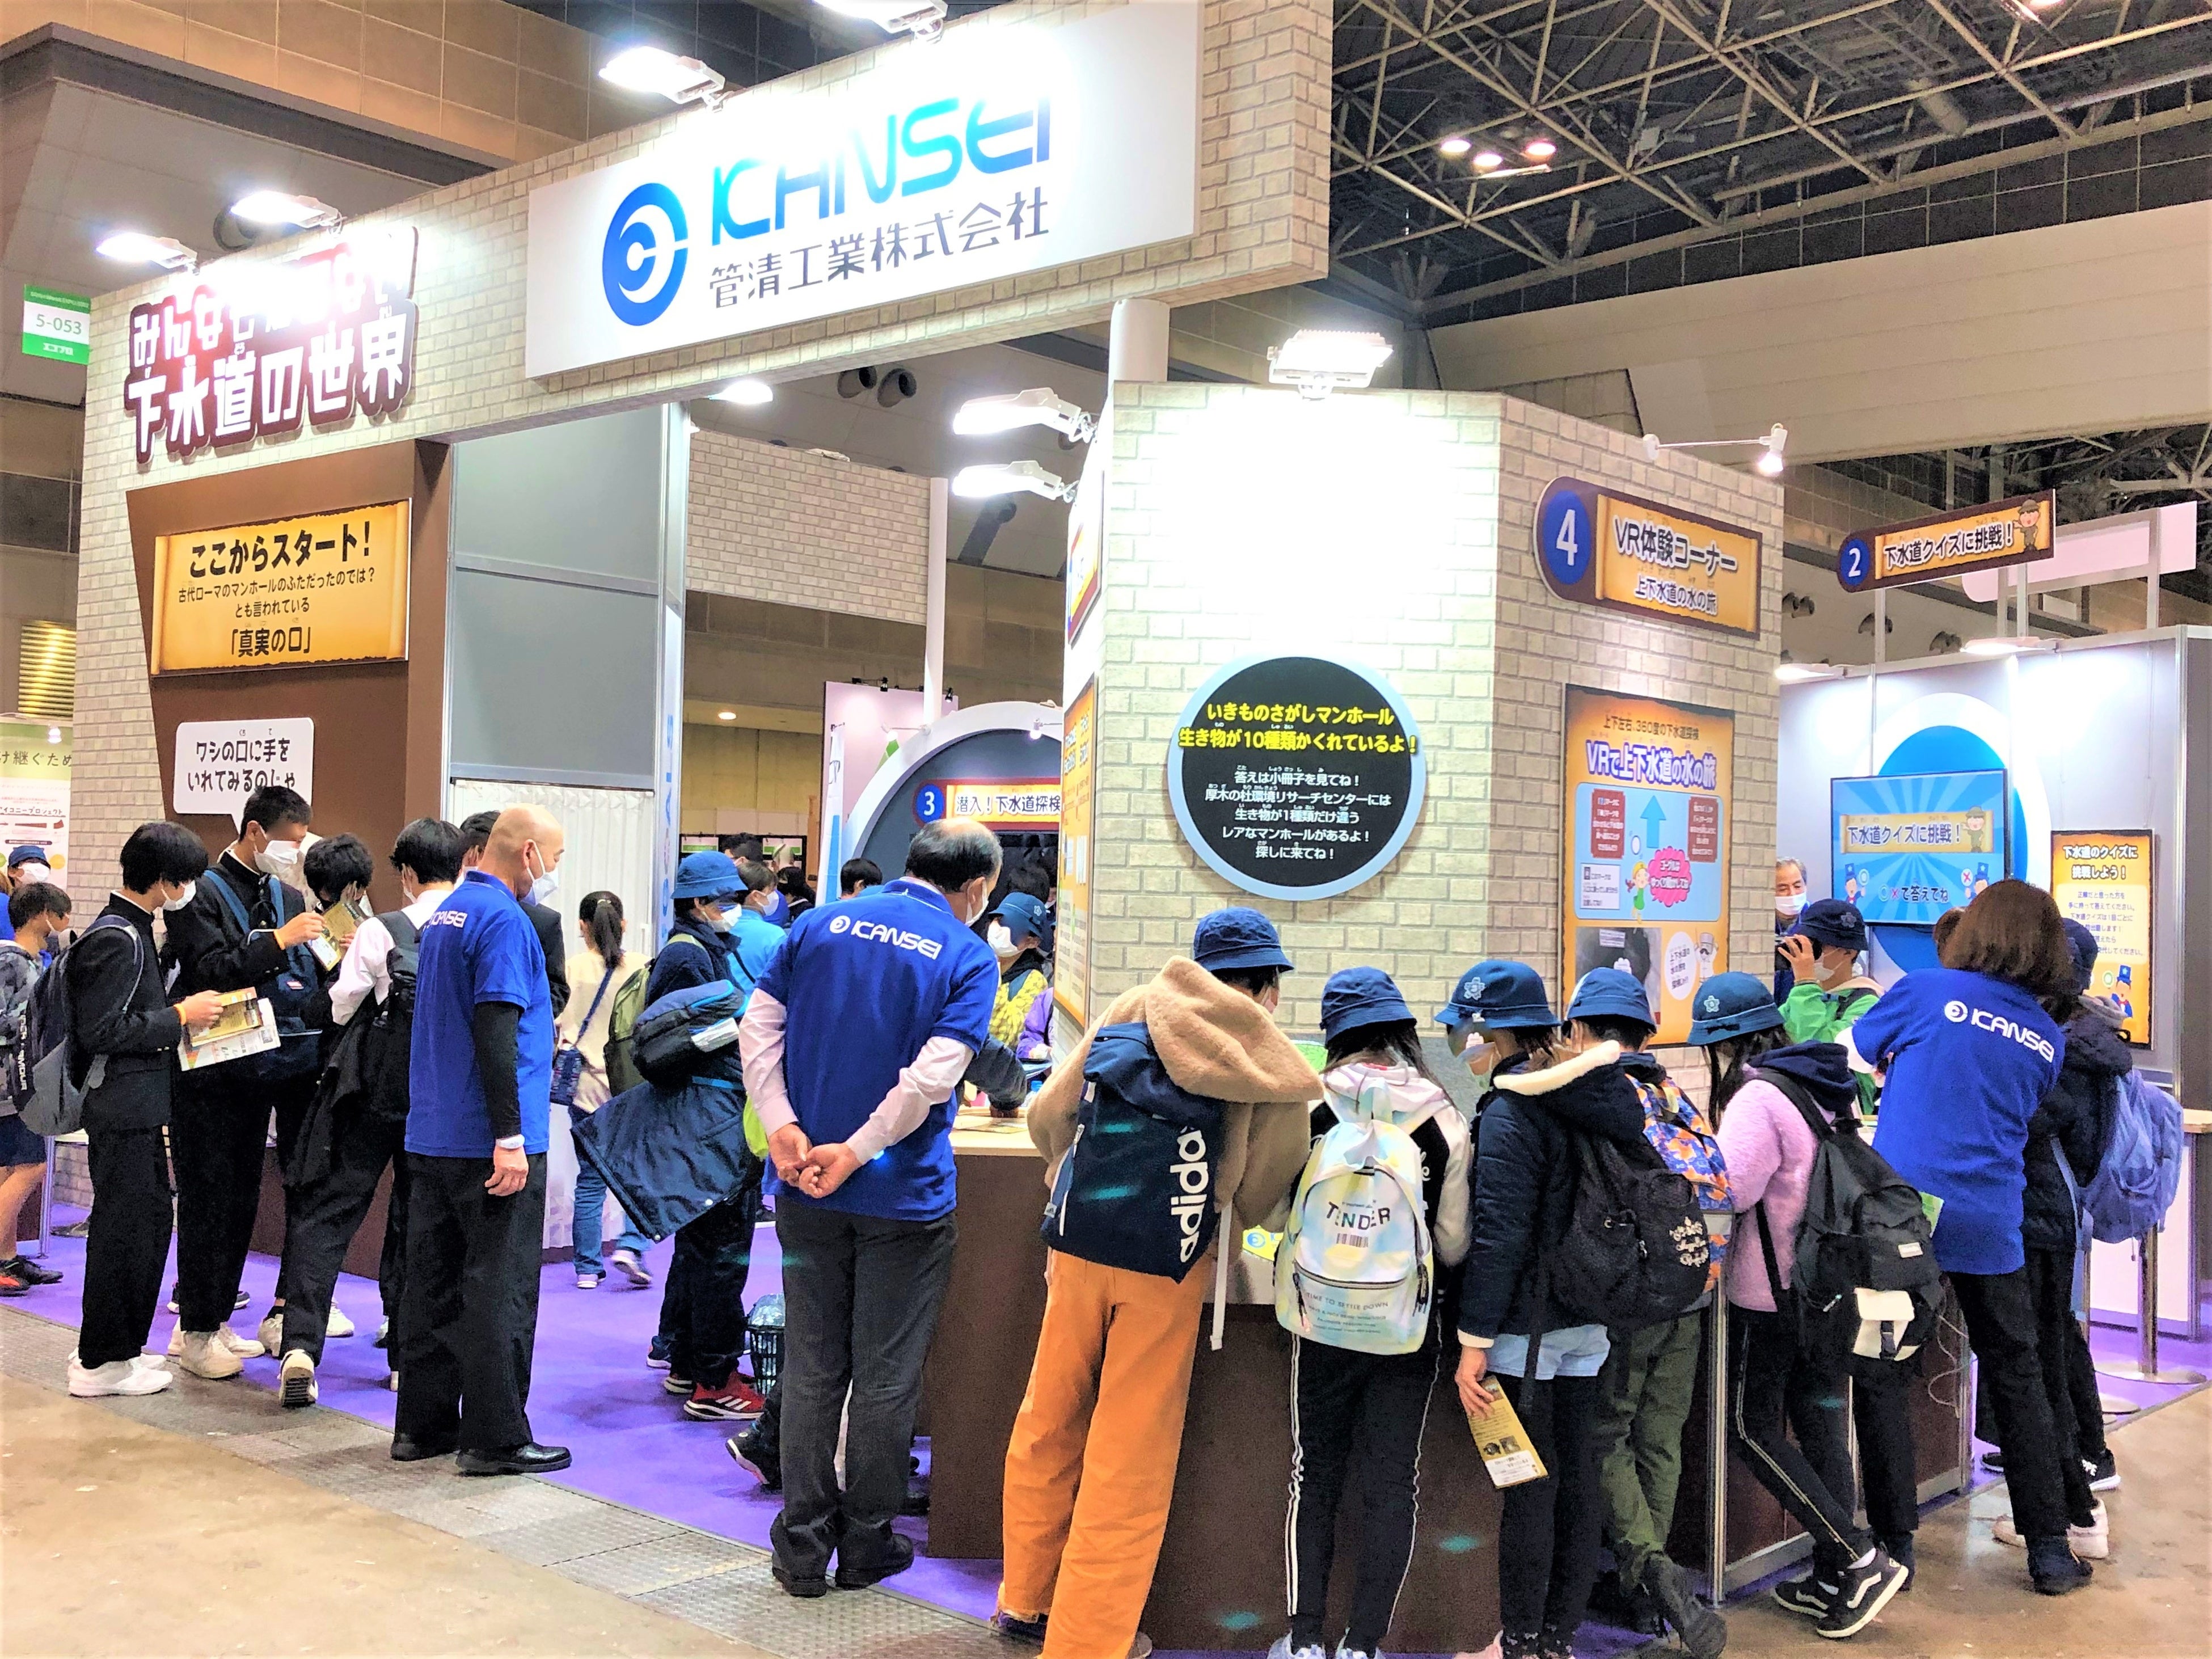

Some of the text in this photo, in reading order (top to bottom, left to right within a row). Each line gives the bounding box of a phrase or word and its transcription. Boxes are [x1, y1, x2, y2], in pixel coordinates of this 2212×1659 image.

[709, 186, 1049, 309] 管清工業株式会社
[36, 314, 82, 335] 5-053
[128, 312, 407, 454] 下水道の世界
[1556, 509, 1578, 567] 4
[1614, 518, 1737, 573] VR体験コーナー
[1848, 547, 1861, 577] 2
[235, 597, 310, 619] とも言われている
[231, 626, 312, 658] 「真実の口」
[1208, 702, 1395, 725] いきものさがしマンホール
[196, 737, 290, 763] ワシの口に手を
[1586, 740, 1717, 790] VRで上下水道の水の旅
[923, 791, 935, 816] 3
[1169, 1126, 1209, 1263] adida
